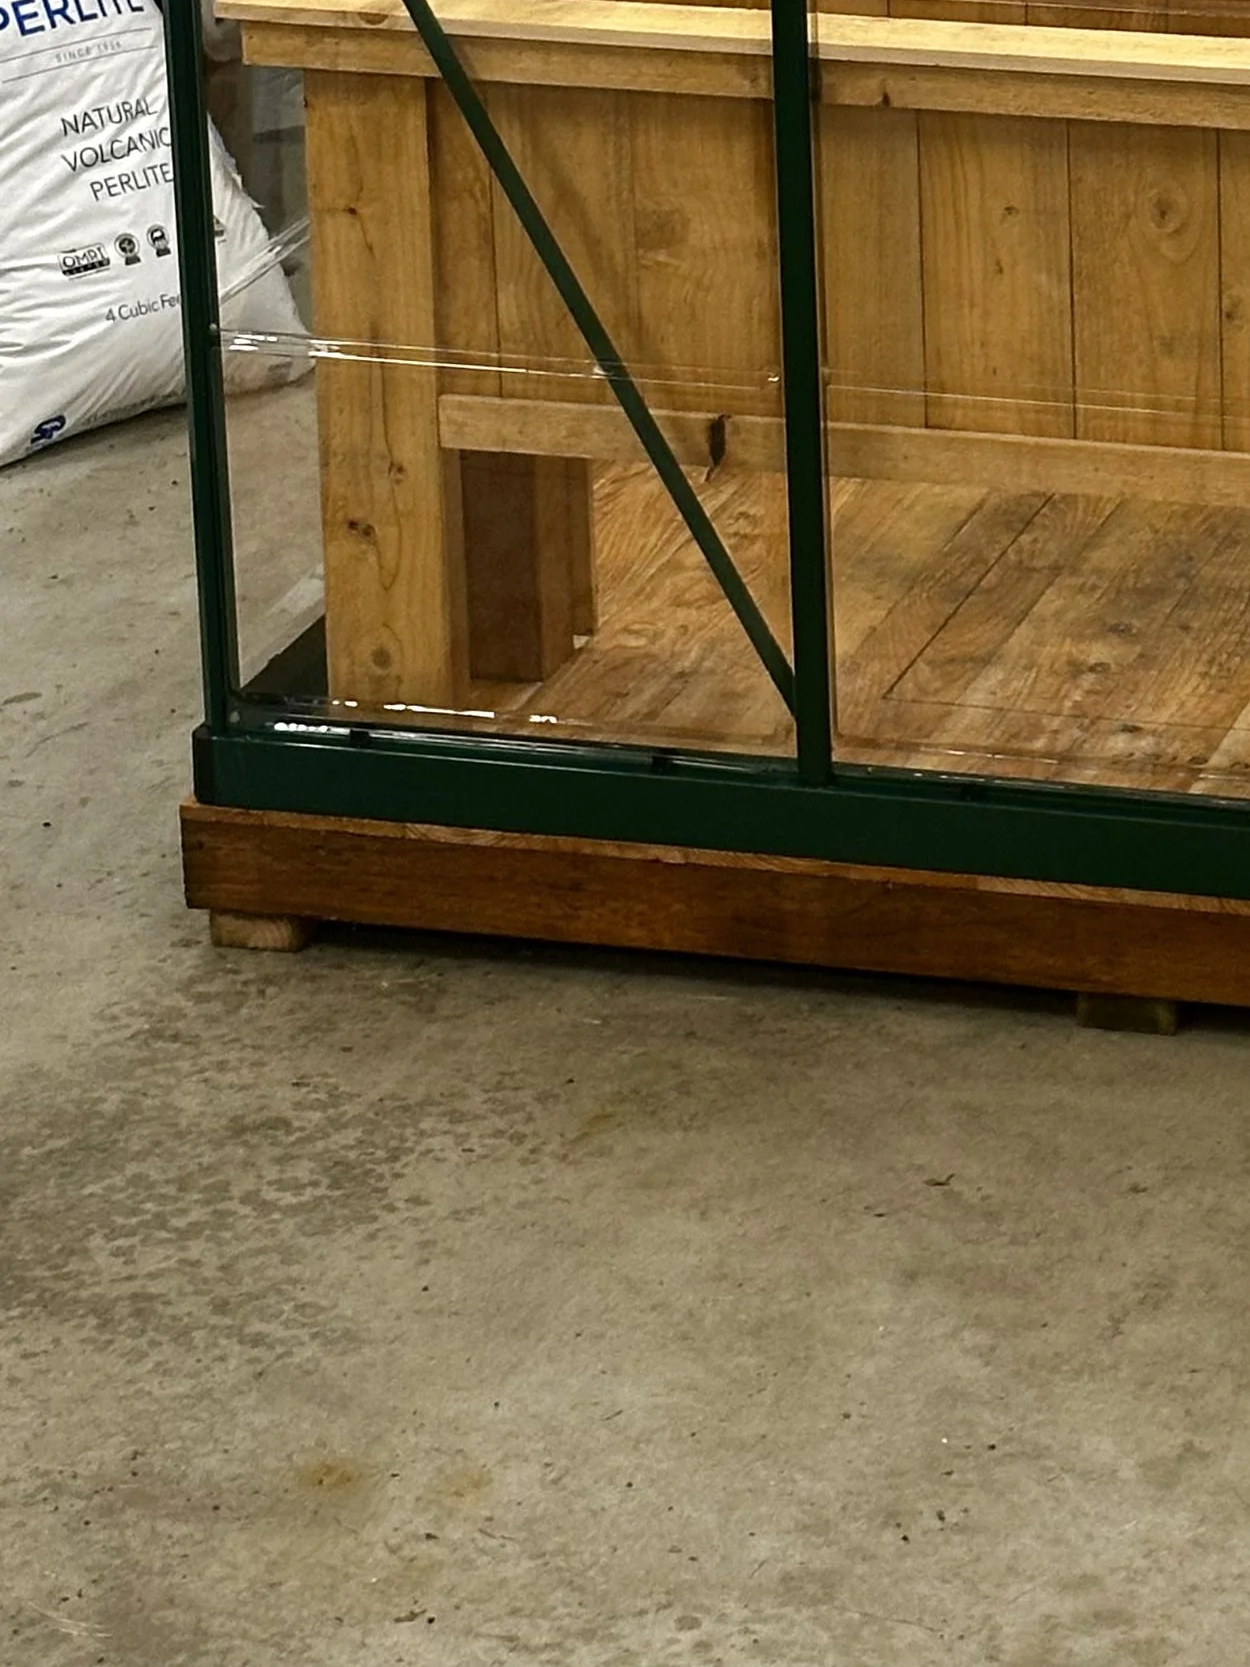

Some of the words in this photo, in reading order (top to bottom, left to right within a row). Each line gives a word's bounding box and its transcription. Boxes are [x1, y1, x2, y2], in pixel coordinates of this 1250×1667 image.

[61, 98, 157, 136] NATURAL
[61, 127, 172, 171] VOLCANIC
[90, 163, 174, 201] PERLITE
[105, 308, 117, 322] 4
[118, 300, 160, 321] Cubic
